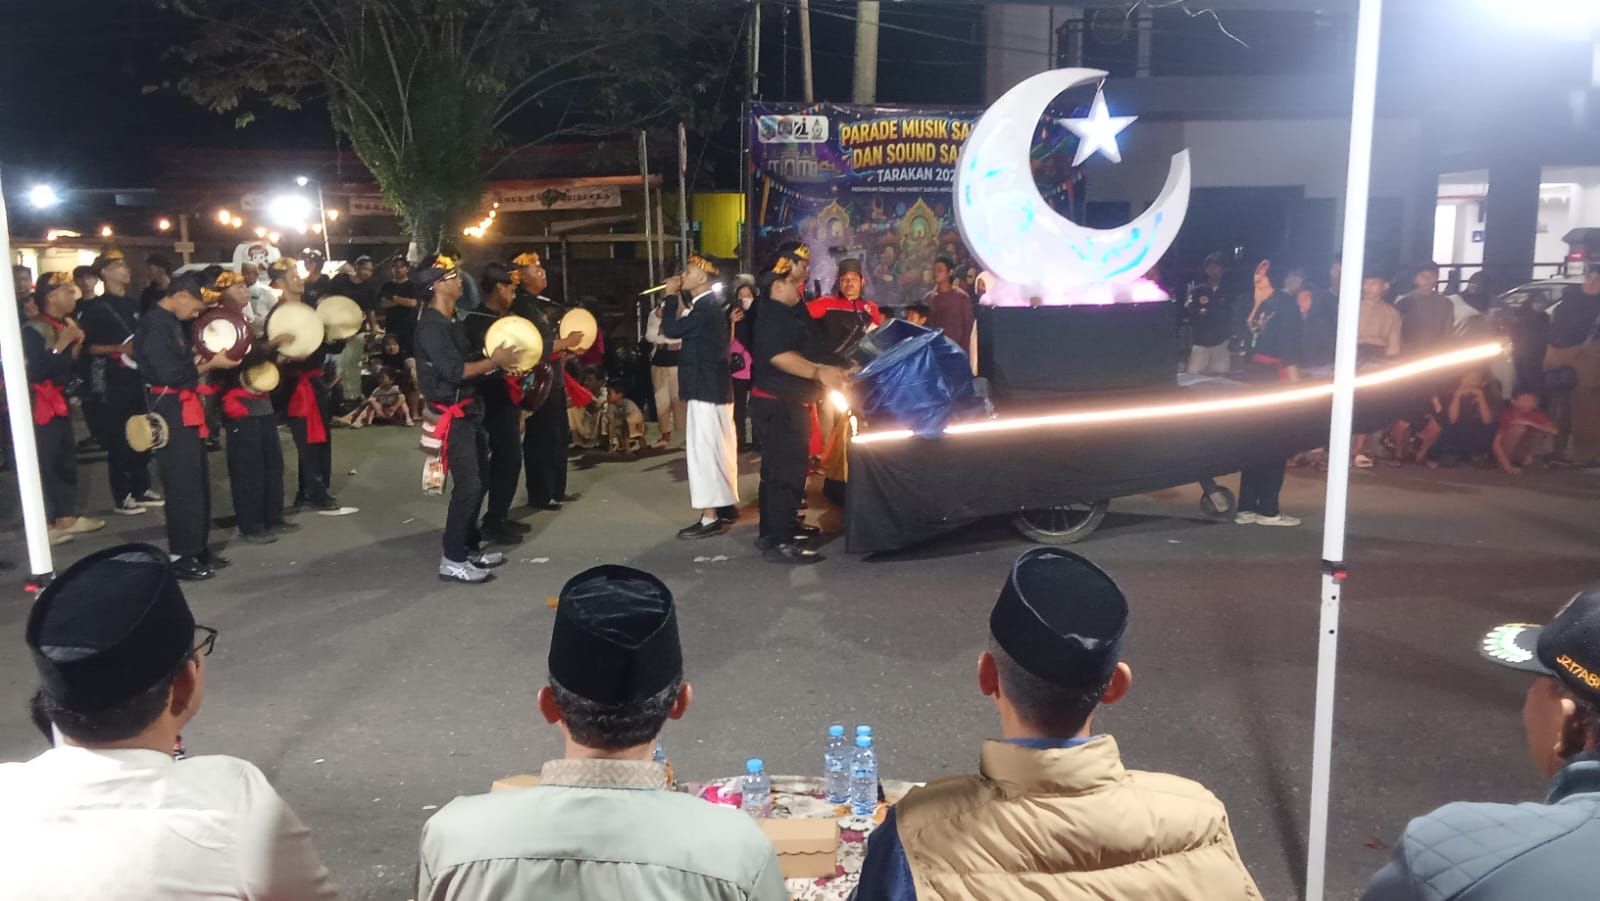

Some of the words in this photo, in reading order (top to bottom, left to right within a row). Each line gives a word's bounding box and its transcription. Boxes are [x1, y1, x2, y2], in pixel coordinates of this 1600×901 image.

[841, 119, 898, 145] PARADE
[902, 118, 948, 139] MUSIK
[951, 120, 974, 141] SA
[852, 144, 883, 170] DAN
[886, 142, 936, 164] SOUND
[876, 167, 933, 183] TARAKAN
